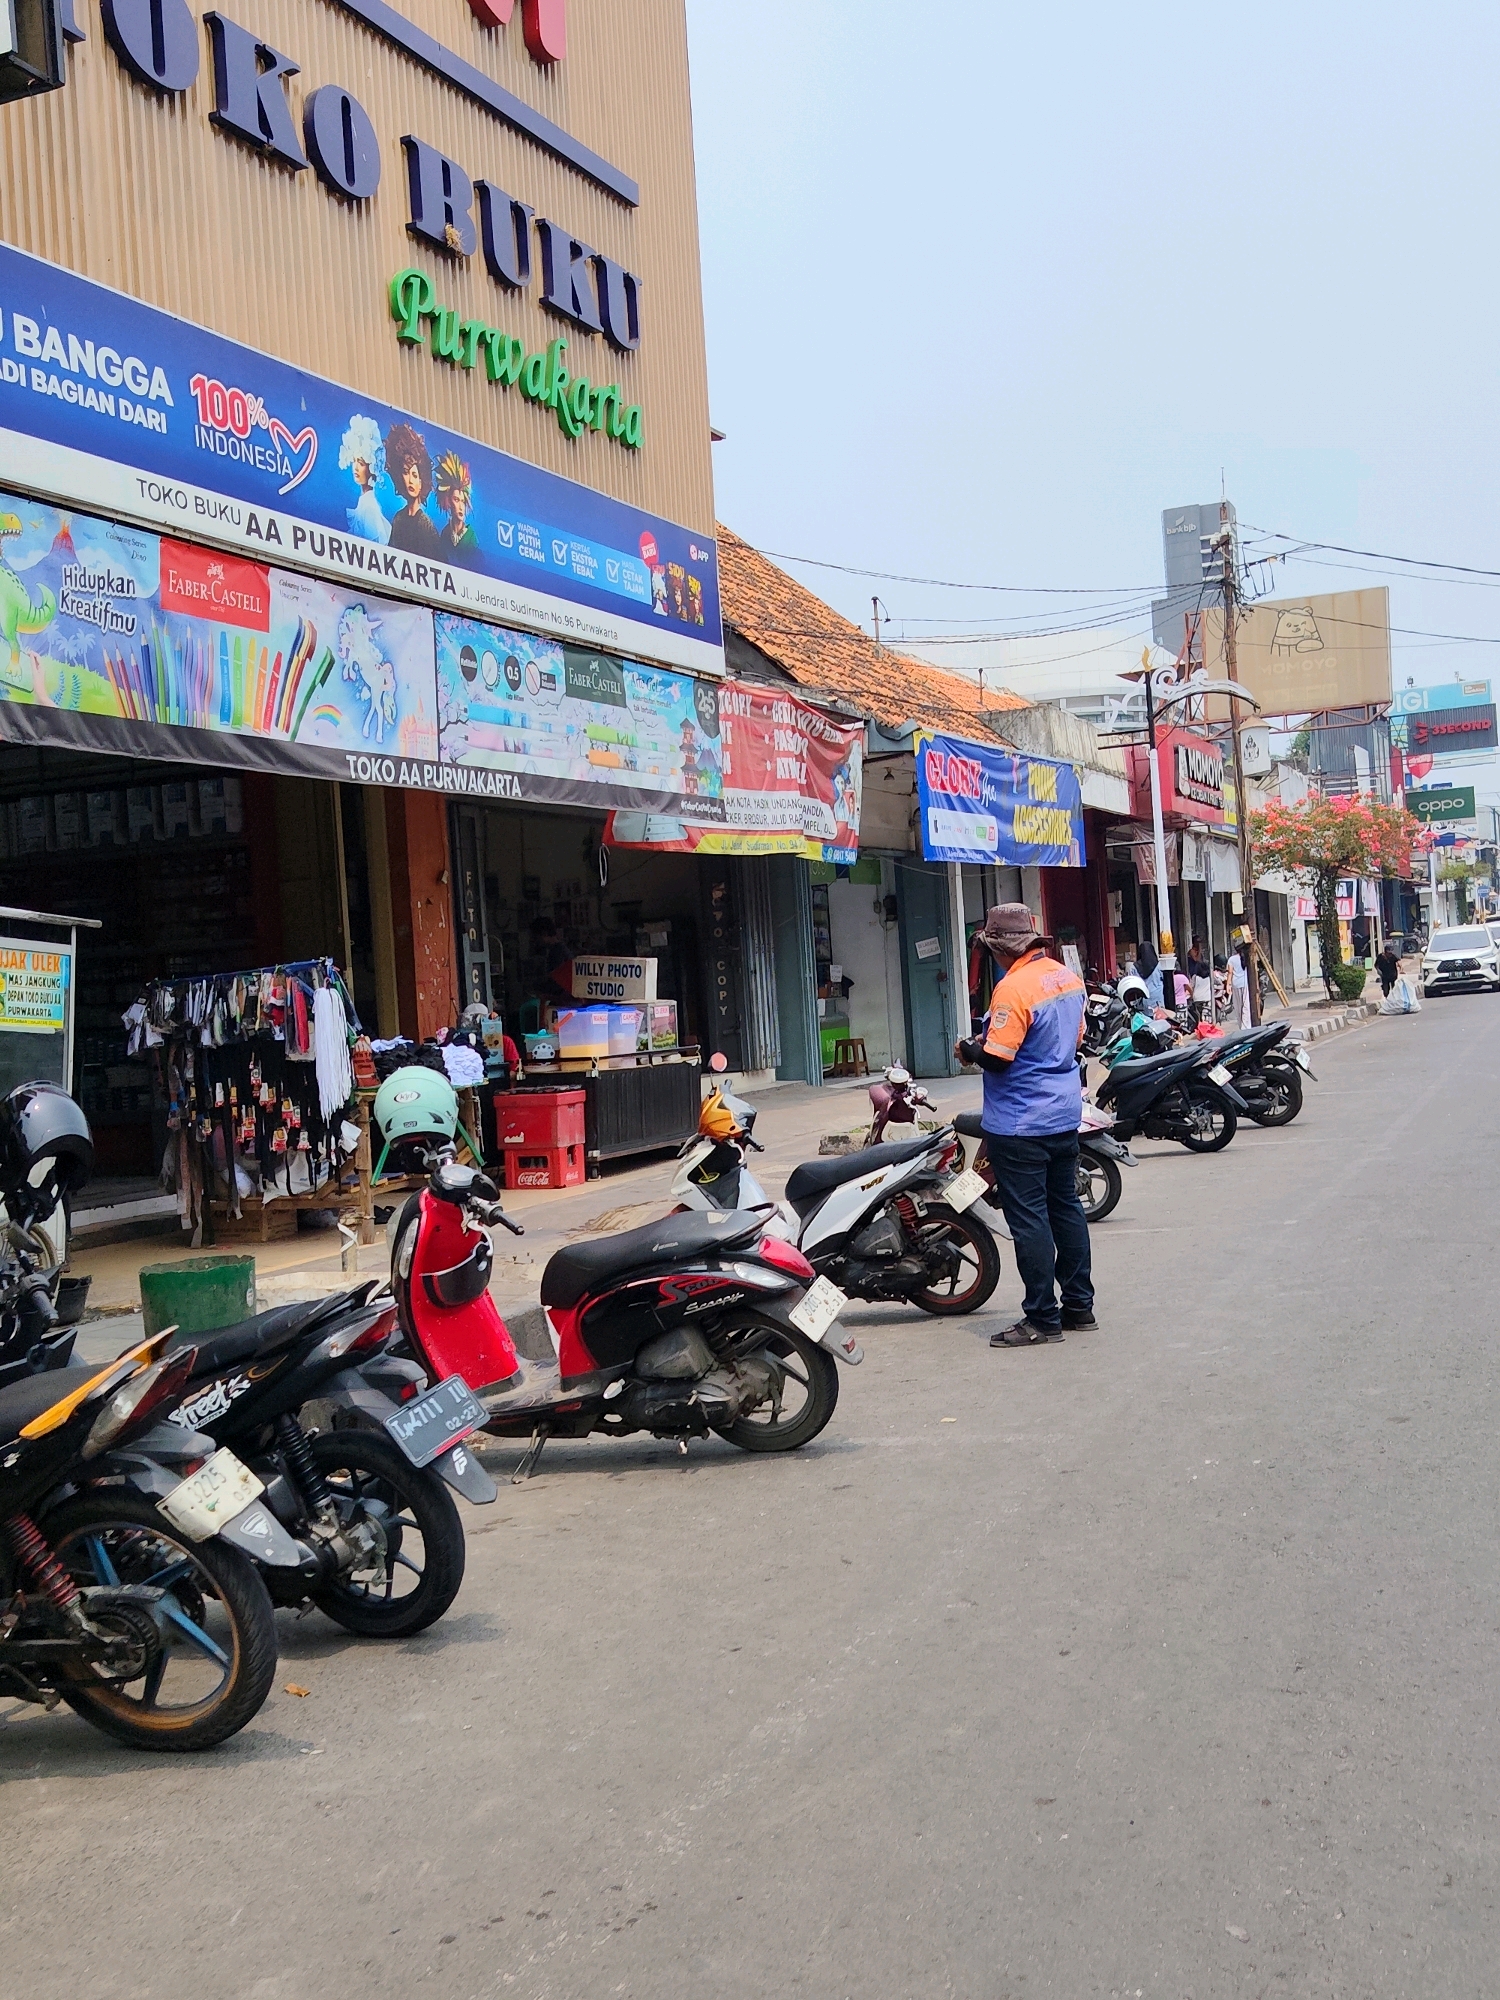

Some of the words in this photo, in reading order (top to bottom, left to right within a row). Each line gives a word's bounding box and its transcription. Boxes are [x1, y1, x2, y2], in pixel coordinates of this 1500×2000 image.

[61, 0, 380, 199] OKO
[401, 135, 642, 352] BUKU
[13, 313, 175, 407] BANGGA
[389, 266, 646, 449] Purwakarta
[31, 367, 116, 417] BAGIAN
[119, 397, 167, 434] DARI
[190, 373, 269, 439] 100%
[195, 424, 294, 479] INDONESIA
[517, 521, 540, 538] WARNA
[518, 531, 541, 549] PUTIH
[136, 478, 189, 510] TOKO
[194, 498, 241, 526] BUKU
[245, 511, 283, 546] AA
[292, 524, 457, 596] PURWAKARTA
[474, 589, 509, 611] Jendral
[510, 599, 550, 622] Sudirman
[576, 618, 619, 642] Purwakarta
[519, 544, 545, 563] CERAH
[571, 551, 598, 569] EKSTRA
[697, 550, 710, 563] APP
[63, 565, 136, 599] Hidupkan
[572, 562, 596, 580] TEBAL
[623, 569, 643, 585] CETAK
[60, 588, 136, 632] Kreatifmu
[506, 665, 519, 681] 0.5
[1432, 718, 1492, 735] 3SECOND
[346, 754, 396, 784] TOKO
[398, 761, 422, 788] AA
[423, 764, 523, 798] PURWAKARTA
[925, 748, 983, 800] GLORY
[1188, 747, 1225, 792] MOMOYO
[1027, 761, 1059, 803] PHONE
[1012, 803, 1074, 847] ACCESSORIES
[32, 953, 61, 973] ULEK
[574, 961, 605, 977] WILLY
[607, 963, 643, 979] PHOTO
[8, 973, 23, 986] MAS
[25, 974, 61, 989] JANGKUNG
[587, 981, 625, 997] STUDIO
[716, 960, 728, 1016] COPY
[7, 989, 24, 1002] DEPAN
[25, 991, 39, 1004] TOKO
[40, 992, 53, 1005] BUKU
[8, 1006, 52, 1018] PURWAKARTA
[683, 1292, 745, 1315] Scoopy
